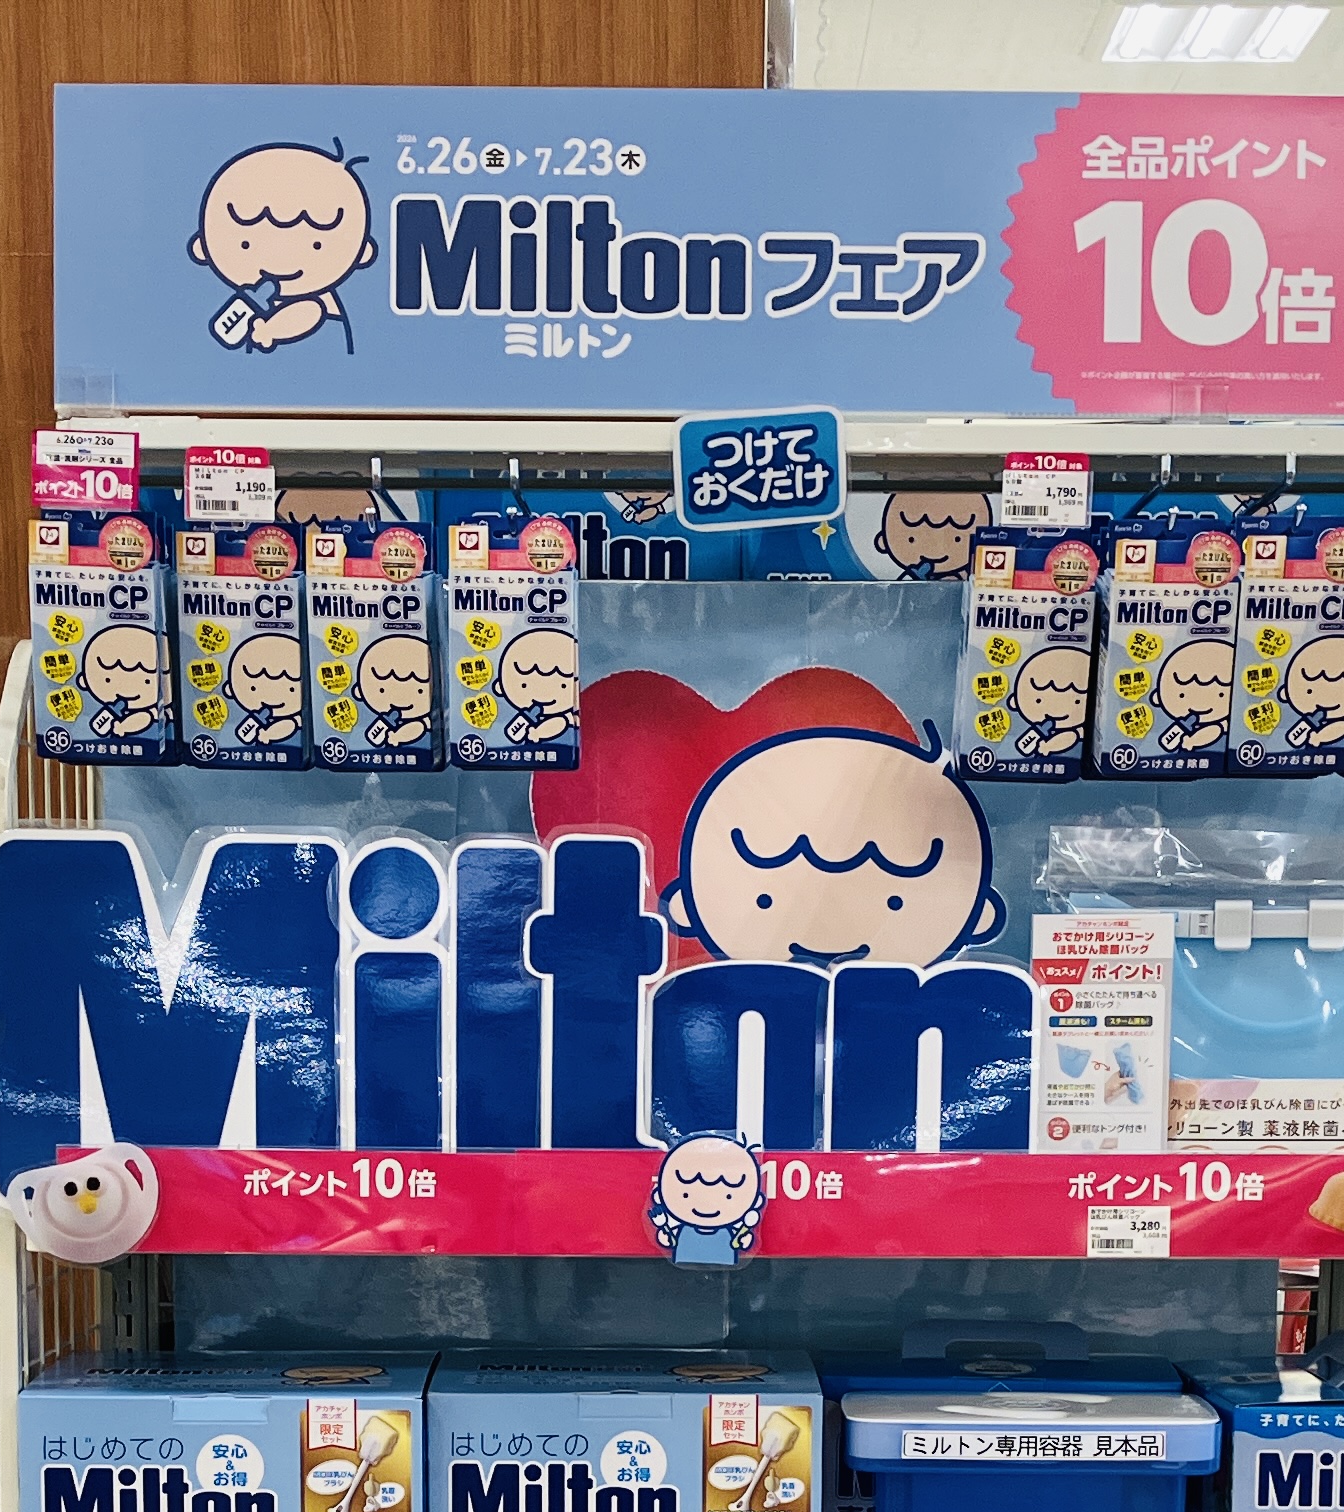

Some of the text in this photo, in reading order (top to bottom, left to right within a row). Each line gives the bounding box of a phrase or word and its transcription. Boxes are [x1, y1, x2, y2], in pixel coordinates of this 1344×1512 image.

[1081, 135, 1327, 180] 全品ポイント
[392, 196, 984, 321] Milton フェア
[1072, 199, 1336, 346] 10倍
[504, 323, 632, 360] ミルトン
[707, 428, 814, 467] つけて
[692, 463, 829, 507] おくだけ
[36, 583, 149, 609] Milton CP
[184, 593, 293, 619] Milton CP
[312, 596, 421, 620] Milton CP
[455, 588, 567, 613] Milton CP
[1246, 596, 1316, 620] Milton
[976, 607, 1089, 631] Milton CP
[1117, 600, 1232, 625] Milton CP
[46, 730, 69, 747] 36
[192, 738, 215, 754] 36
[324, 741, 345, 757] 36
[461, 739, 483, 755] 36
[971, 750, 993, 767] 60
[1113, 748, 1135, 764] 60
[1239, 744, 1262, 760] 60
[1052, 931, 1155, 943] おでかけ用シリコーン
[1056, 944, 1150, 955] ほ乳びん除菌バッグ
[243, 1158, 437, 1199] ポイント10倍
[1068, 1161, 1266, 1203] ポイント10倍
[320, 1424, 343, 1435] 限定
[722, 1419, 746, 1431] 限定
[42, 1436, 184, 1461] はじめての
[212, 1443, 248, 1460] 安心
[451, 1432, 589, 1457] はじめての
[616, 1439, 652, 1456] 安心
[911, 1434, 1163, 1458] ミルトン専用容器 見本品
[213, 1472, 247, 1487] お得
[617, 1467, 651, 1483] お得
